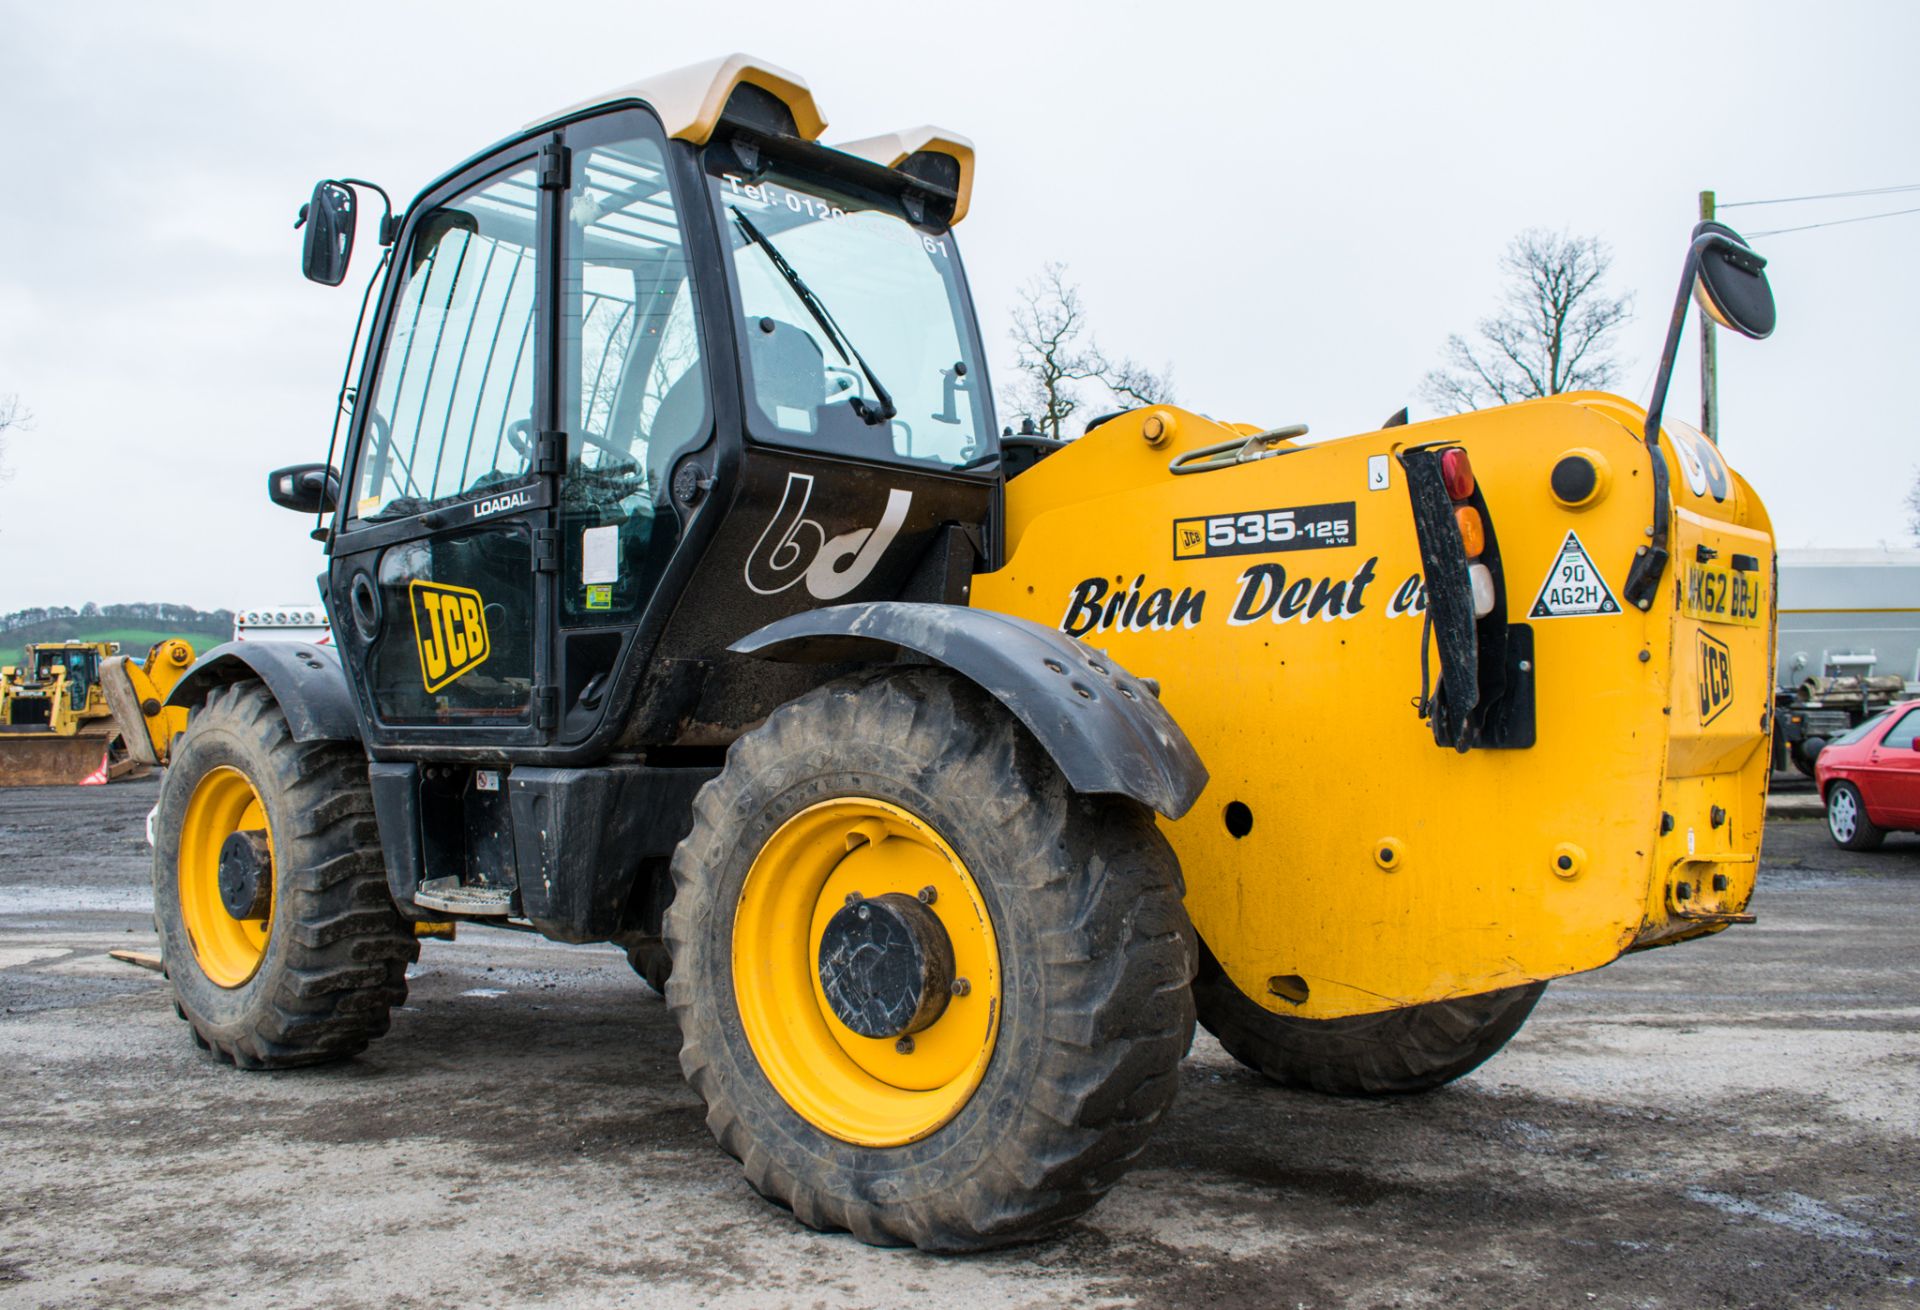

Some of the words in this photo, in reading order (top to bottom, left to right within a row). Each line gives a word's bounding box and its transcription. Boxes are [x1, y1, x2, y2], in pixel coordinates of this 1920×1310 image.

[722, 173, 778, 206] Tel:
[1183, 530, 1201, 547] JCB
[1059, 574, 1206, 639] Brian
[1227, 556, 1379, 627] Dent
[1550, 586, 1598, 606] AG2H
[422, 591, 484, 681] JCB
[1700, 641, 1730, 717] JCB
